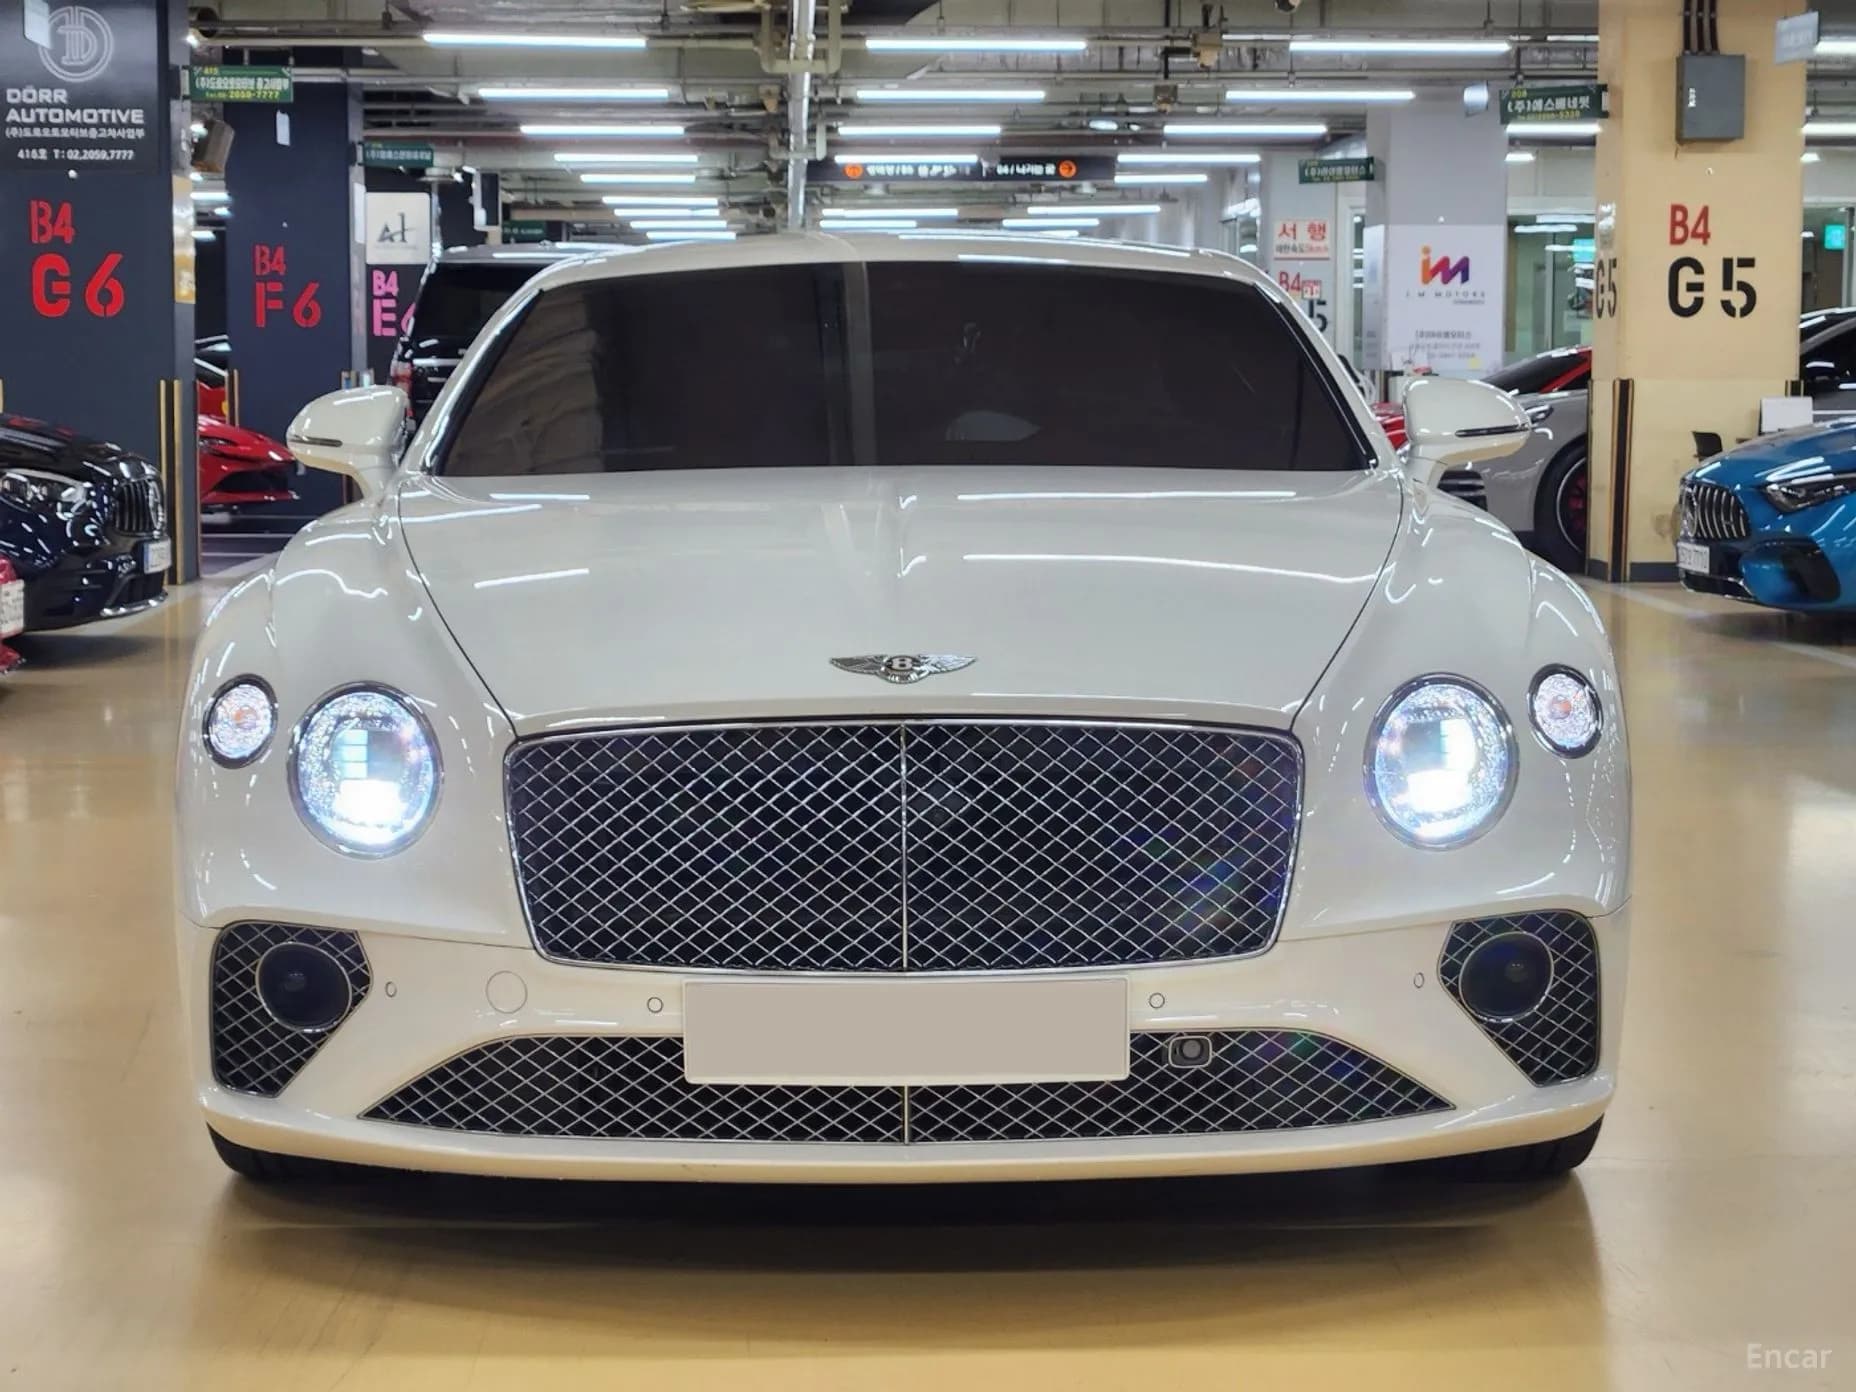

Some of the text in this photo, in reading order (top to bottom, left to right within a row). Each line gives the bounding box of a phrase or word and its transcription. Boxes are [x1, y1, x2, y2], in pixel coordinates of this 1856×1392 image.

[5, 107, 145, 124] AUTOMOTIVE
[30, 200, 75, 244] B4
[1669, 203, 1712, 246] B4
[254, 244, 287, 276] B4
[372, 269, 400, 296] B4
[1278, 270, 1302, 293] B4
